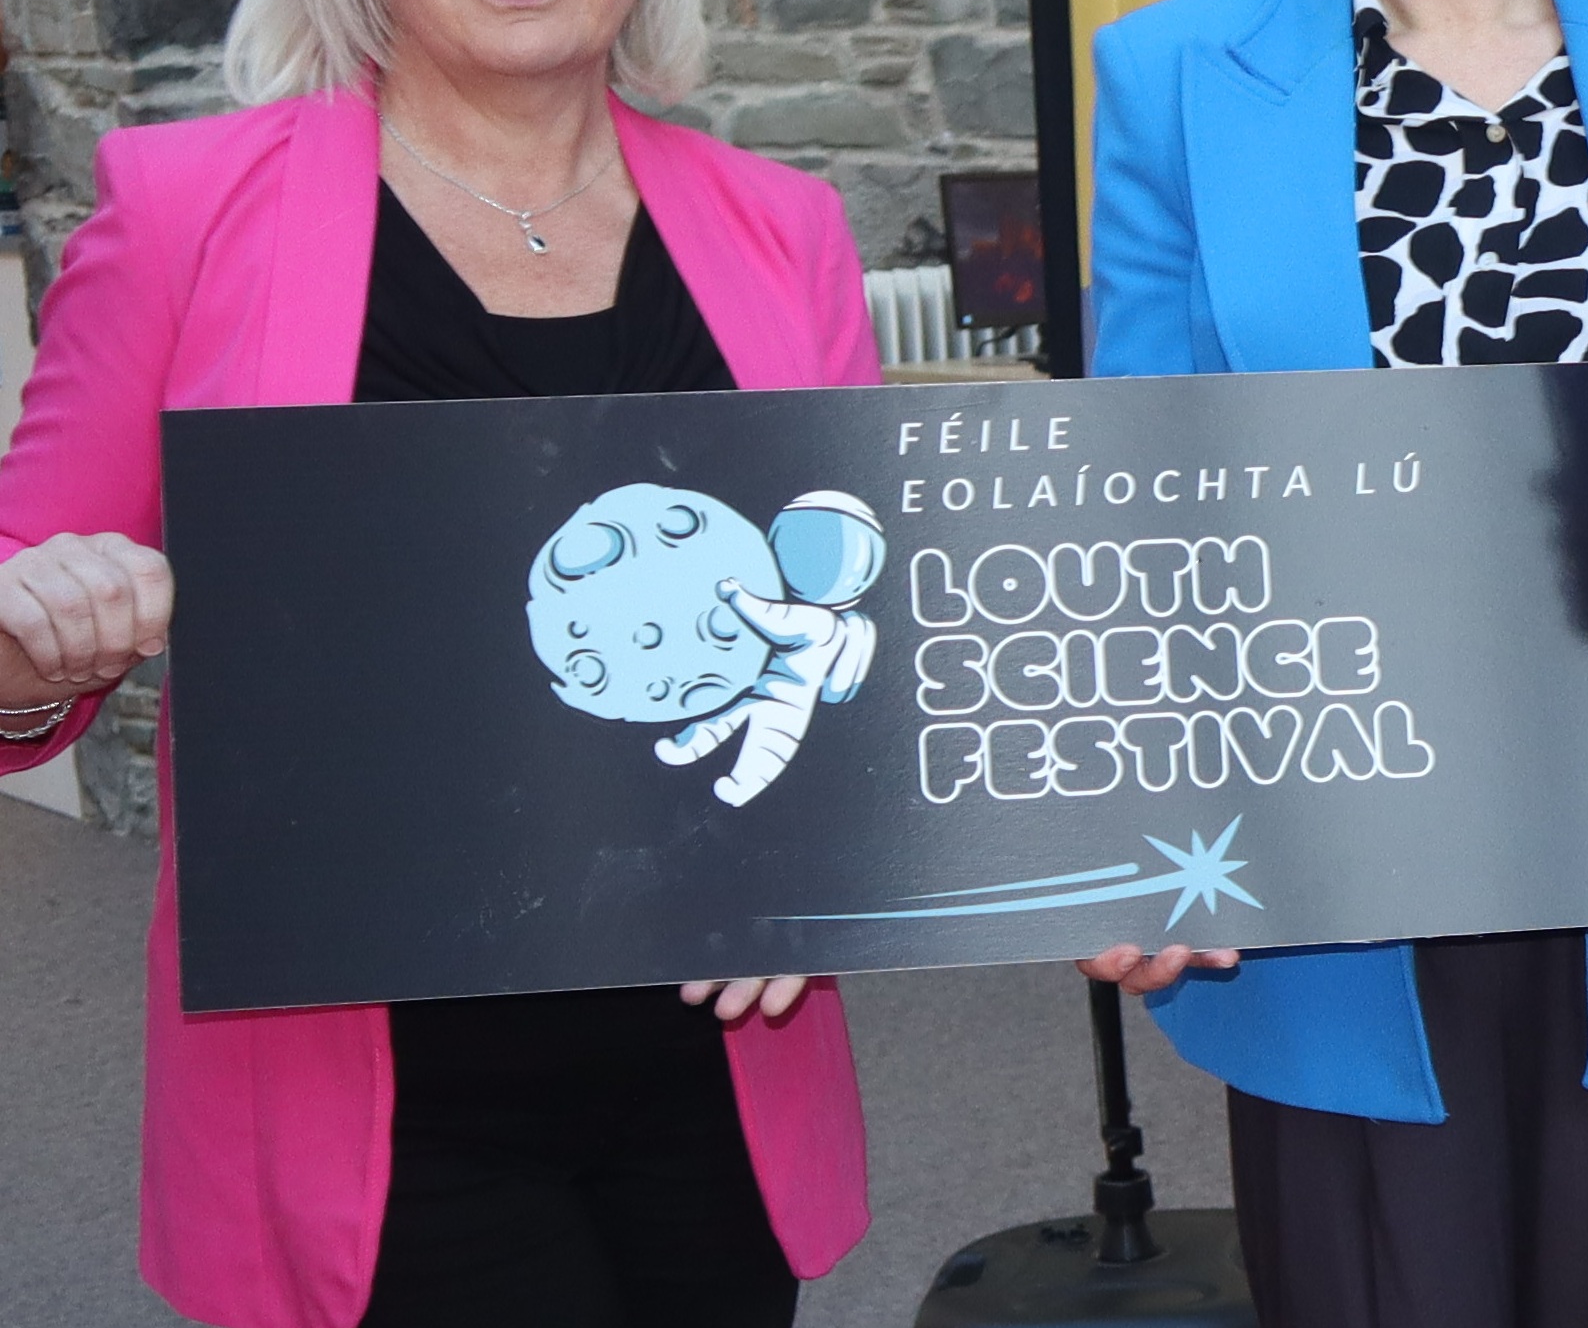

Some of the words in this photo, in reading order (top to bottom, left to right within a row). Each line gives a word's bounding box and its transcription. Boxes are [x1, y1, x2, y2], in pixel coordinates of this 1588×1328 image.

[899, 412, 1073, 456] FÉILE
[902, 462, 1314, 514] EOLAÍOCHTA
[1355, 453, 1423, 495] LÚ
[910, 534, 1272, 630] LOUTH
[914, 615, 1382, 716] SCIENCE
[917, 701, 1436, 803] FESTIVAL
